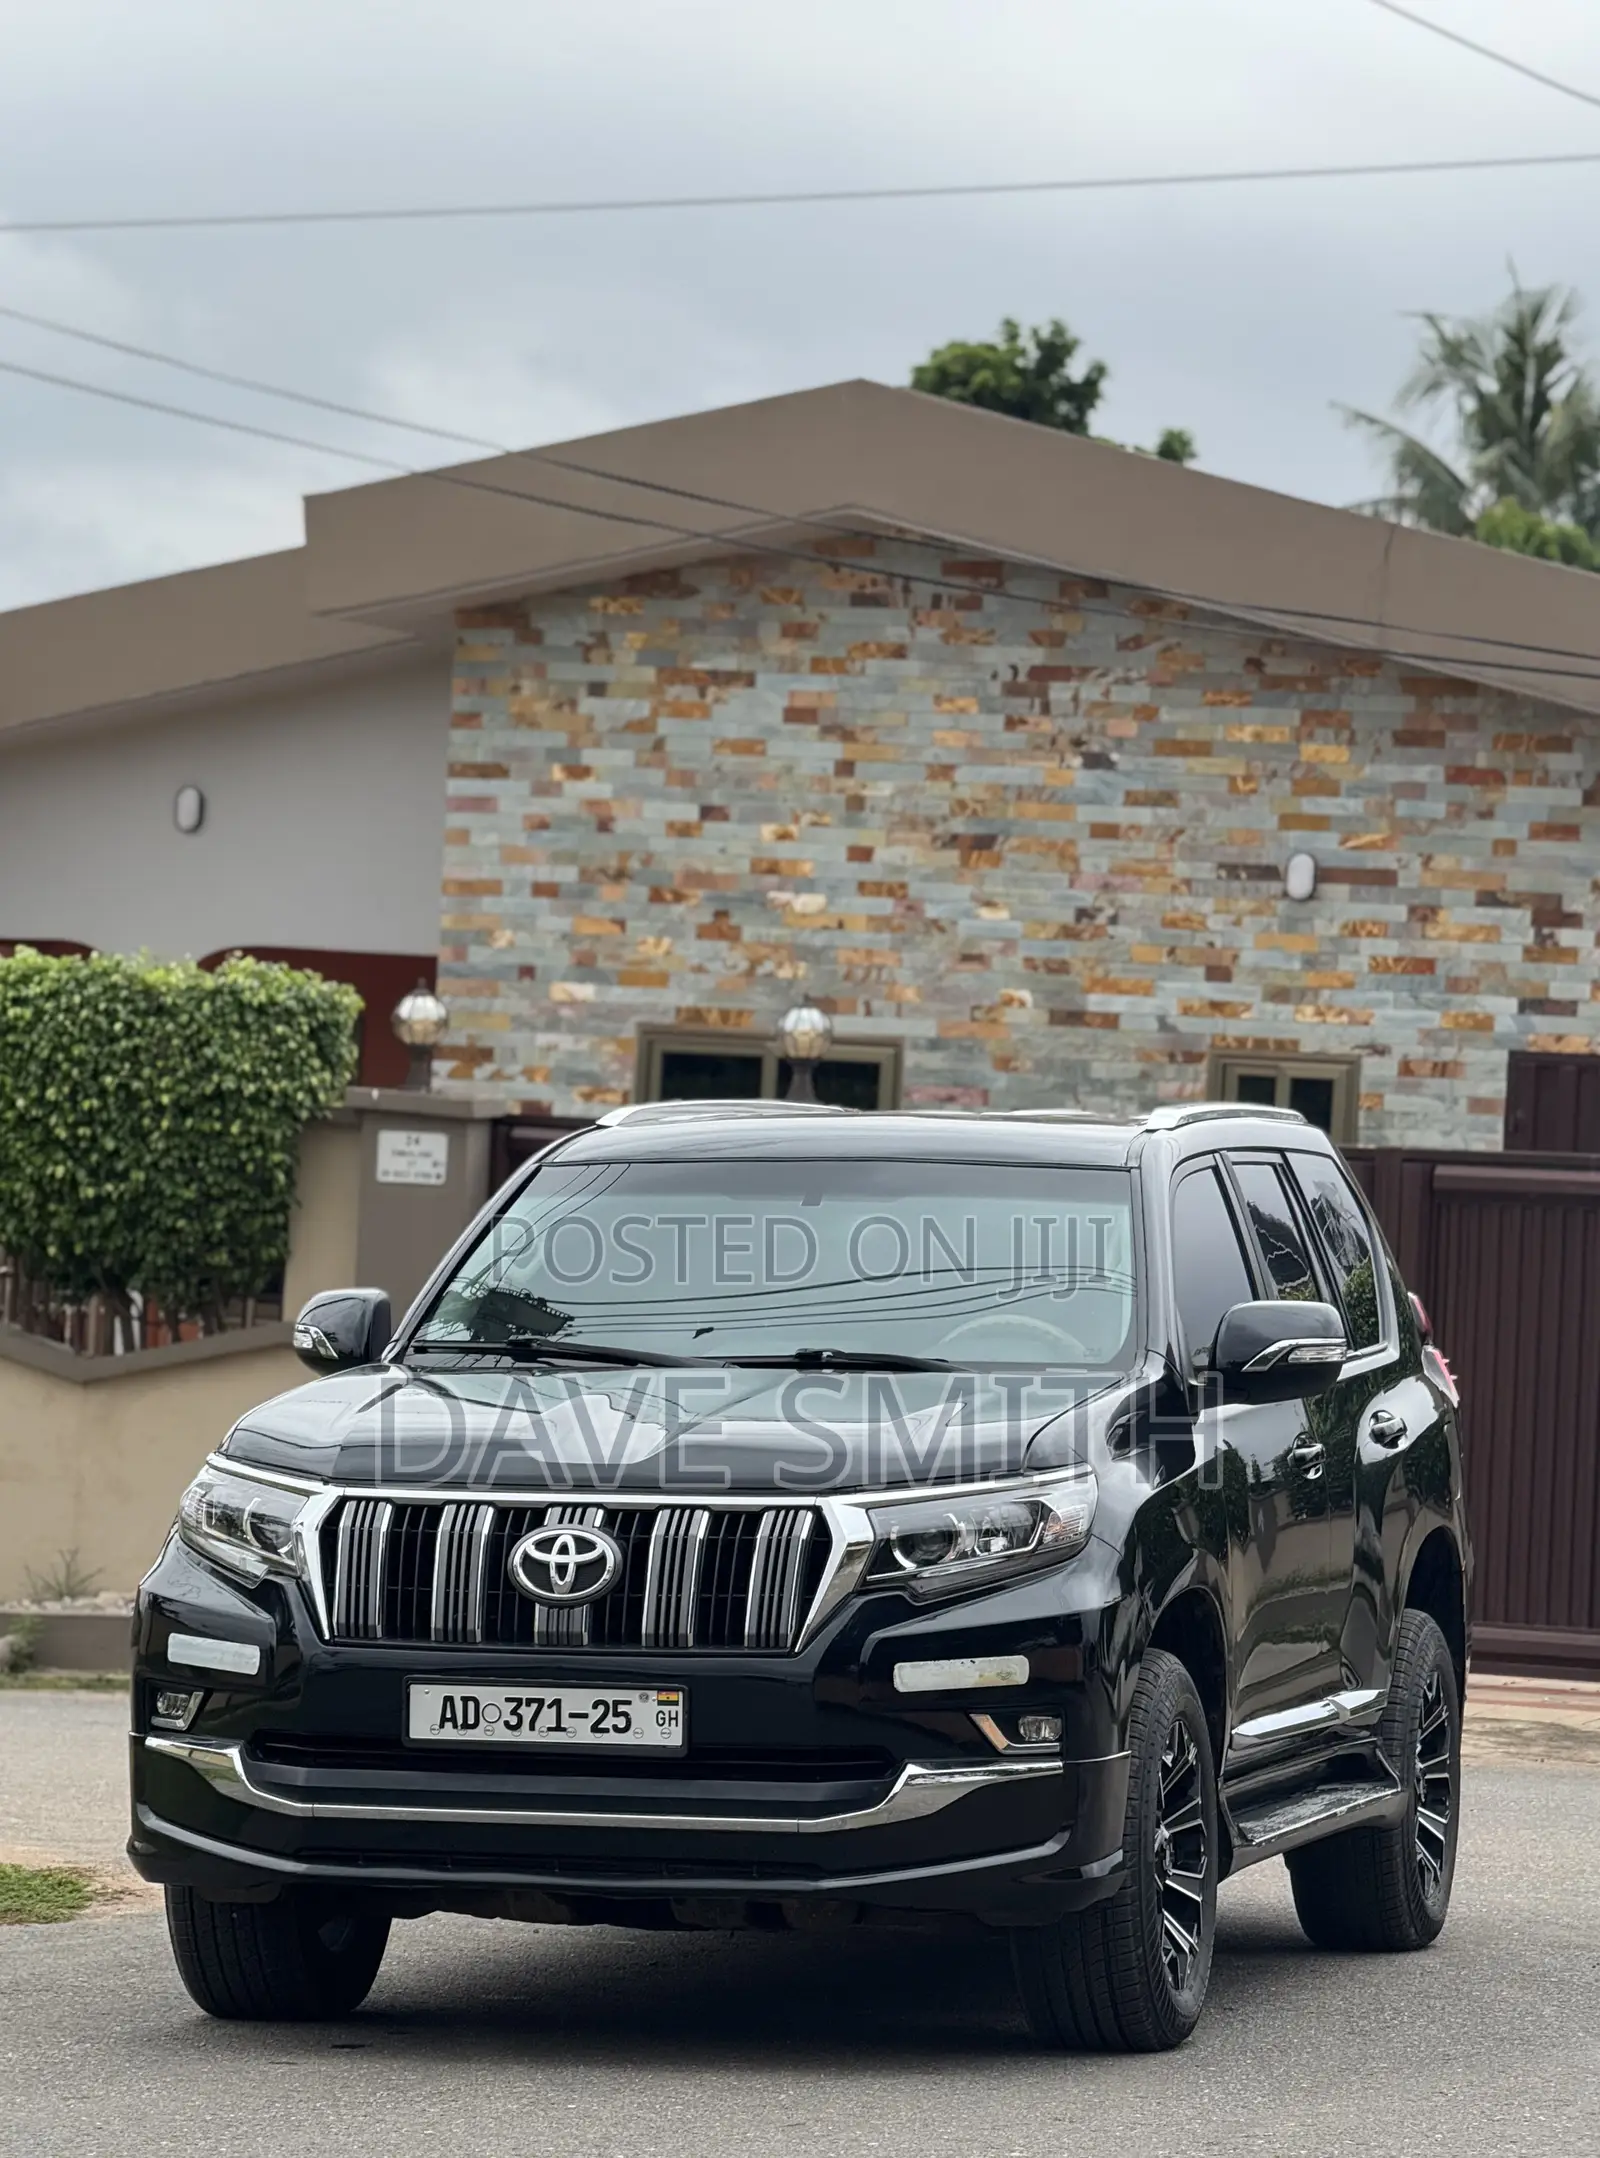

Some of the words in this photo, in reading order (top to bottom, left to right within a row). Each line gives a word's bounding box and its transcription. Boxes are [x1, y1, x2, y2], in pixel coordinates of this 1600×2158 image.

[439, 1695, 480, 1730] AD
[503, 1697, 633, 1734] 371-25
[655, 1710, 679, 1727] GH
